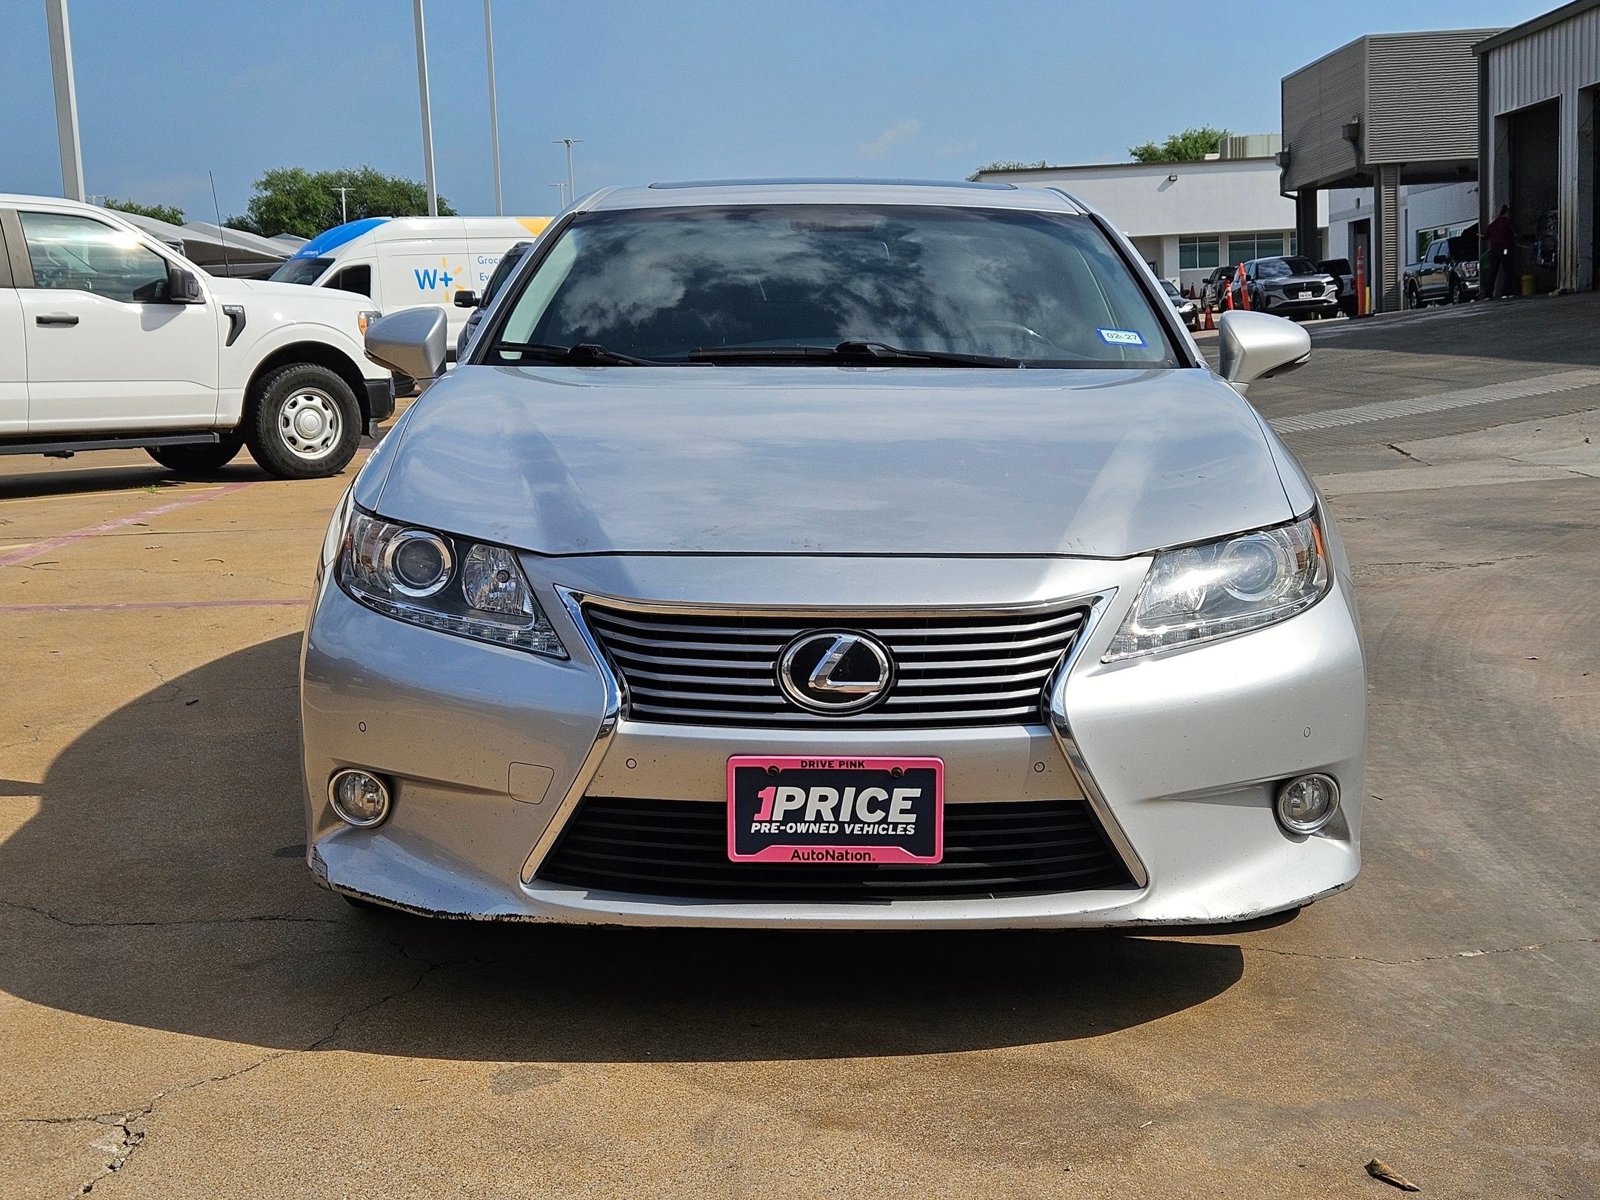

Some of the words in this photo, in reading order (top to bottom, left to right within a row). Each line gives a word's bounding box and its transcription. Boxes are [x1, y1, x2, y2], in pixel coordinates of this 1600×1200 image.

[477, 255, 501, 265] Groc
[414, 268, 453, 290] W+
[800, 760, 835, 769] DRIVE
[838, 760, 866, 769] PINK
[753, 786, 922, 823] 1PRICE
[750, 822, 839, 834] PRE-OWNED
[844, 823, 916, 835] VEHICLES
